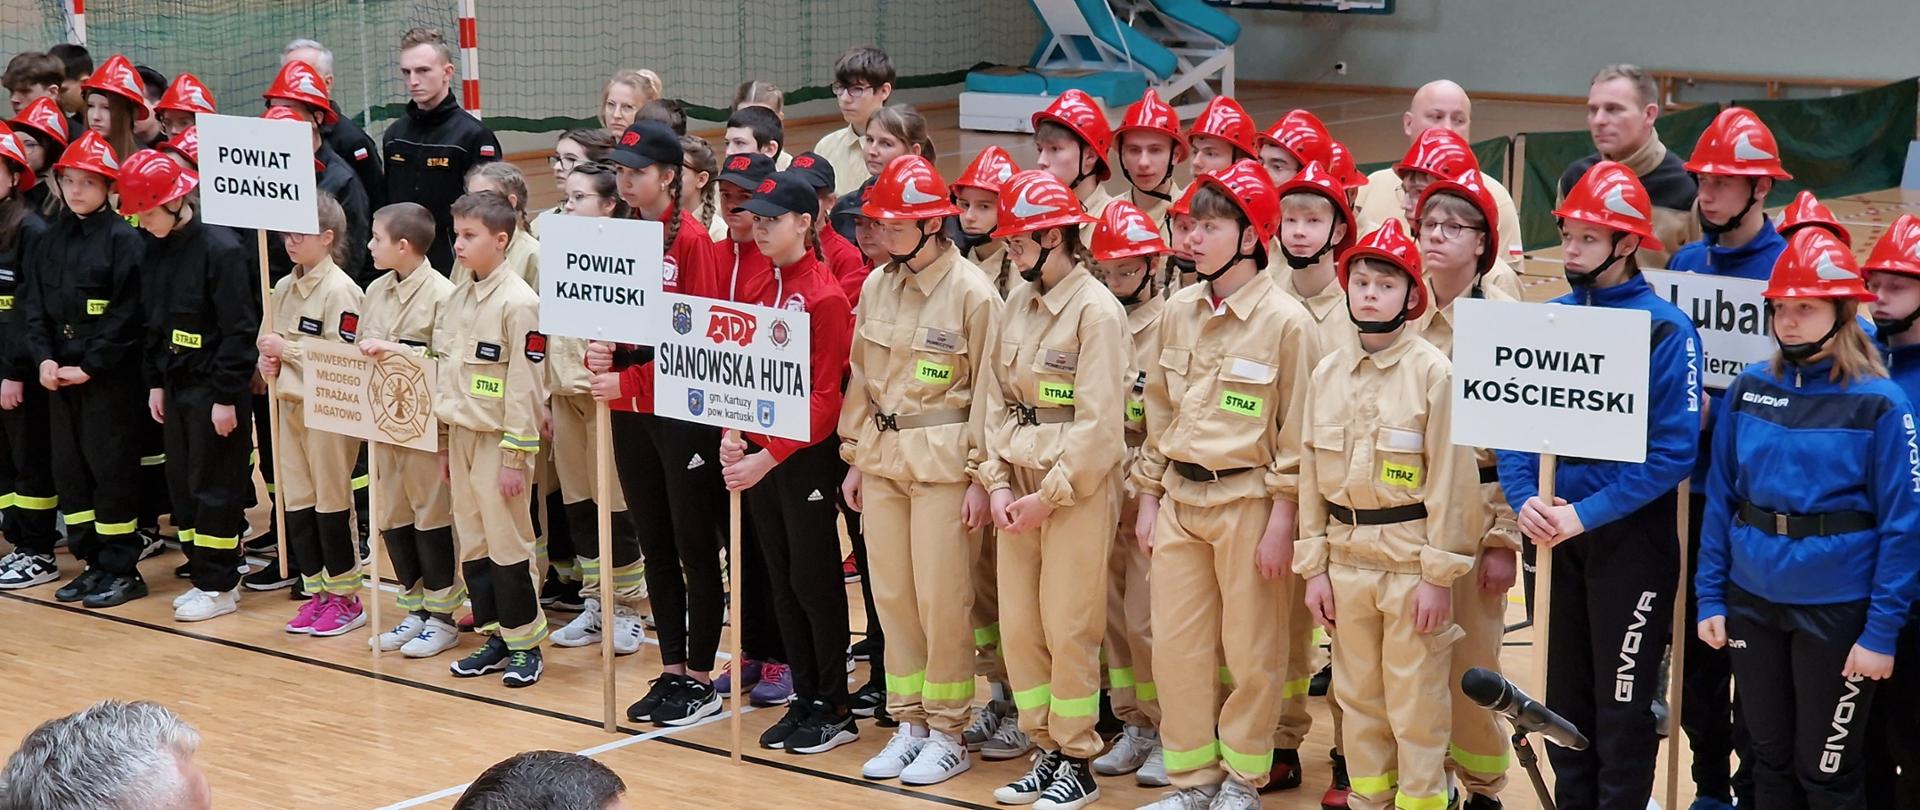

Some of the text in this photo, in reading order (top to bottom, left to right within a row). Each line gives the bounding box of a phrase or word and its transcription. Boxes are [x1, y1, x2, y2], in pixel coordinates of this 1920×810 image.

[218, 146, 291, 170] POWIAT
[214, 176, 300, 201] GDAŃSKI
[566, 253, 636, 276] POWIAT
[556, 281, 645, 306] KARTUSKI
[307, 351, 367, 371] UNIWERSYTET
[659, 342, 805, 397] SIANOWSKA HUTA
[1495, 346, 1605, 375] POWIAT
[316, 369, 361, 387] MŁODEGO
[1685, 337, 1699, 412] GIVOVA
[315, 387, 360, 404] STRAŻAKA
[709, 393, 752, 410] gm. Kartuzy
[1463, 377, 1635, 414] KOŚCIERSKI
[1742, 391, 1789, 409] GIVOVA
[313, 404, 362, 422] JAGATOWO
[725, 408, 754, 423] kartuski
[1615, 591, 1657, 702] GIVOVA
